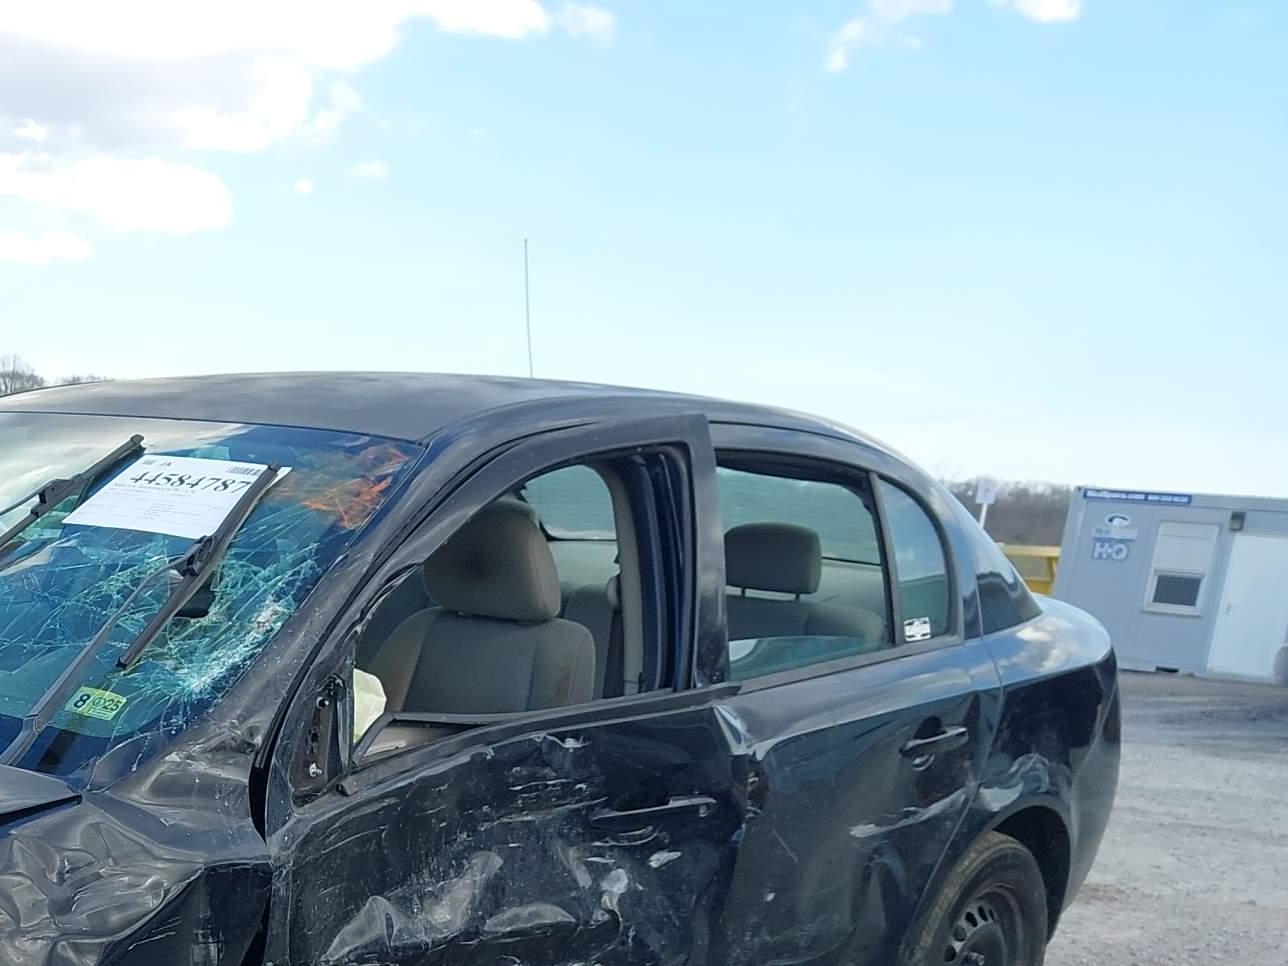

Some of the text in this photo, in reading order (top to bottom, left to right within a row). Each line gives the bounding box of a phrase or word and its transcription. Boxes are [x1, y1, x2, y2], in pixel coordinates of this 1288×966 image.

[130, 471, 251, 493] 44584787
[73, 693, 91, 708] 8
[103, 699, 123, 712] 25
